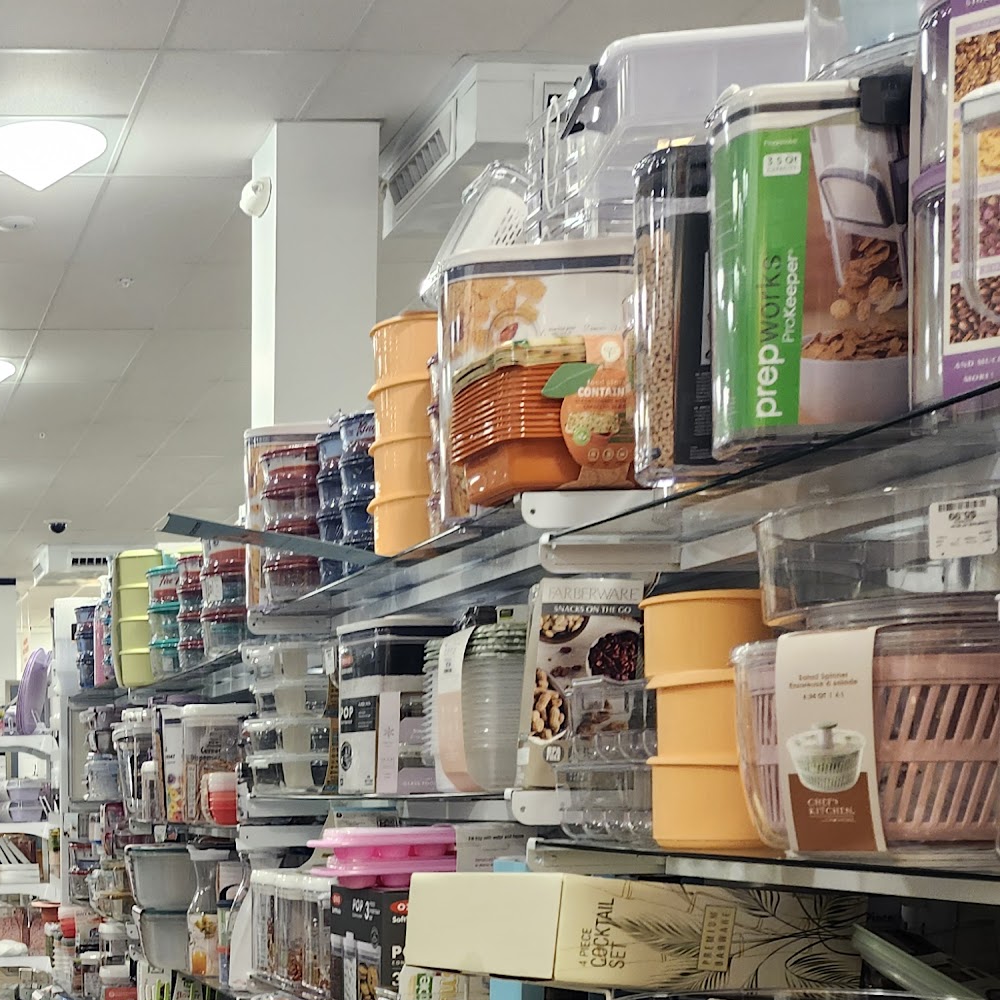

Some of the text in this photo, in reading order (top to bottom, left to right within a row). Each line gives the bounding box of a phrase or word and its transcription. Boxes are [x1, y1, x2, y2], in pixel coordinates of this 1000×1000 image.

[755, 254, 785, 418] prepworks
[617, 605, 632, 614] GO
[590, 897, 615, 969] COCKTAIL
[609, 941, 629, 970] SET
